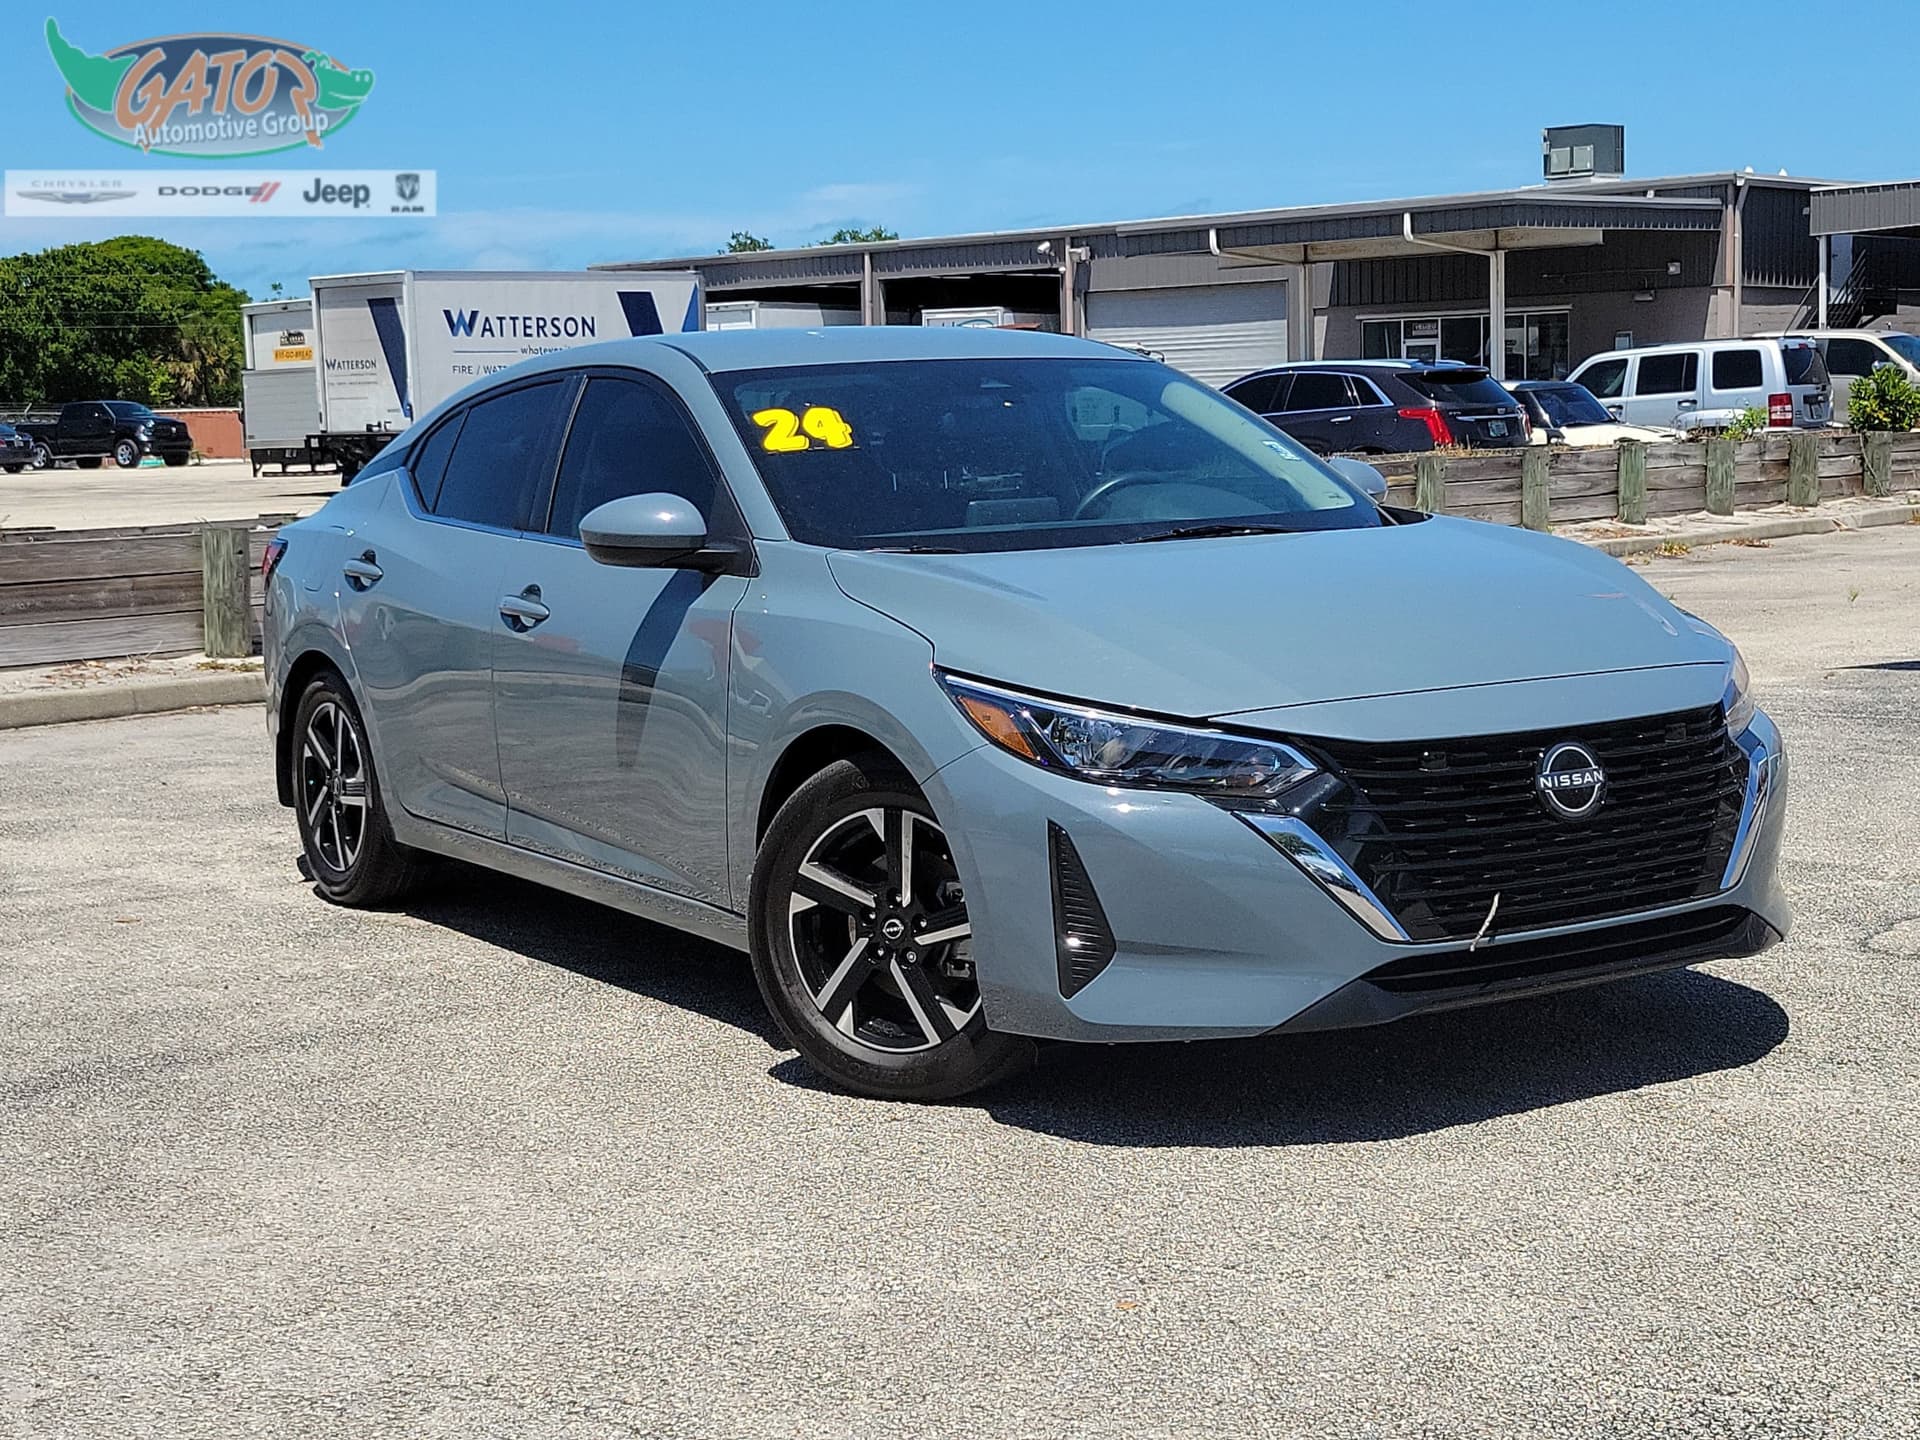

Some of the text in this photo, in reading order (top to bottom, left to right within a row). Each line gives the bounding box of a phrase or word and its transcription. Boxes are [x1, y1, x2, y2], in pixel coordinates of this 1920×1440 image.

[452, 365, 473, 375] FIRE
[752, 406, 853, 453] 24
[1539, 769, 1604, 789] NISSAN
